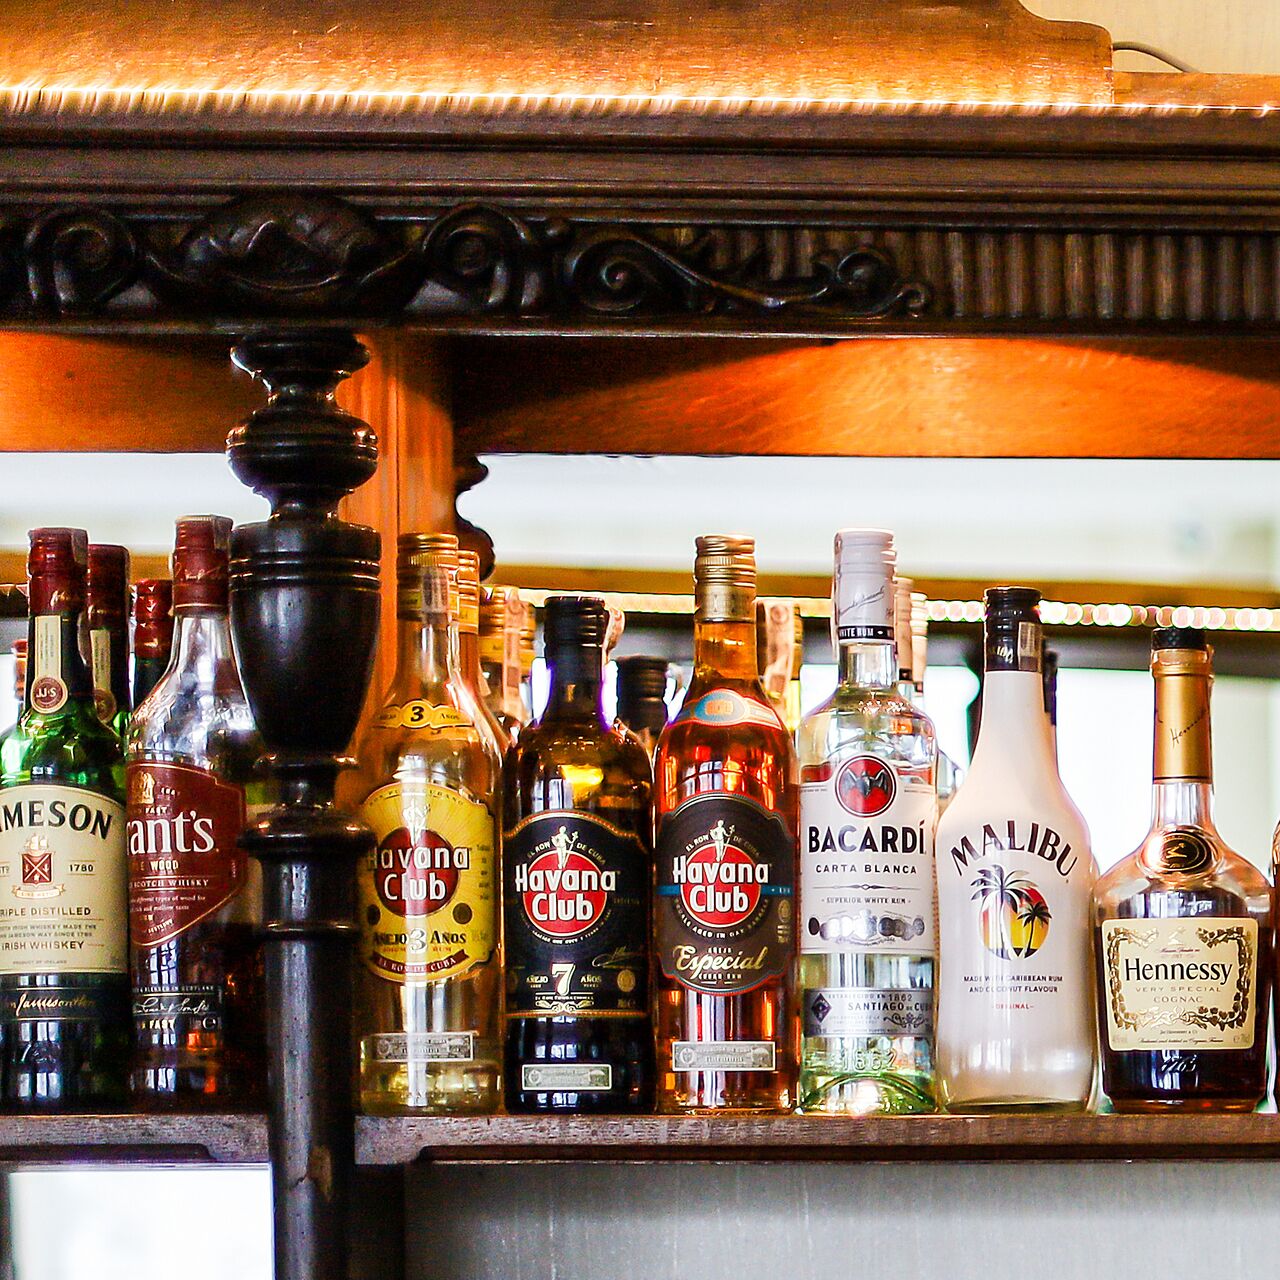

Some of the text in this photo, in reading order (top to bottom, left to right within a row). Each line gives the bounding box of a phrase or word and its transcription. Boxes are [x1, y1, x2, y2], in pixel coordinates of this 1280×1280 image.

[410, 706, 424, 721] 3
[0, 800, 114, 840] MESON
[126, 810, 214, 856] rant's
[808, 819, 925, 855] BACARDÍ
[367, 846, 471, 871] Havana
[950, 820, 1078, 877] MALIBU
[69, 864, 94, 873] 1780
[515, 863, 616, 892] Havana
[673, 855, 769, 884] Havana
[815, 864, 917, 874] CARTA BLANCA
[169, 879, 209, 887] WHISKY
[384, 871, 447, 901] Club
[532, 893, 594, 921] Club
[689, 885, 749, 912] Club
[826, 896, 906, 905] SUPERIOR WHITE RUM
[0, 906, 92, 917] RIPLE DISTILLED
[2, 940, 85, 951] IRISH WHISKEY
[409, 927, 427, 952] 3
[430, 957, 457, 971] CUBA
[673, 946, 769, 980] Especial
[1125, 957, 1233, 986] Hennessy
[552, 963, 576, 996] 7
[1024, 985, 1058, 993] FLAVOUR
[848, 1002, 905, 1011] SANTIAGO
[914, 1002, 930, 1012] CUB
[888, 993, 913, 1002] 1862
[1153, 996, 1204, 1004] COGNAC
